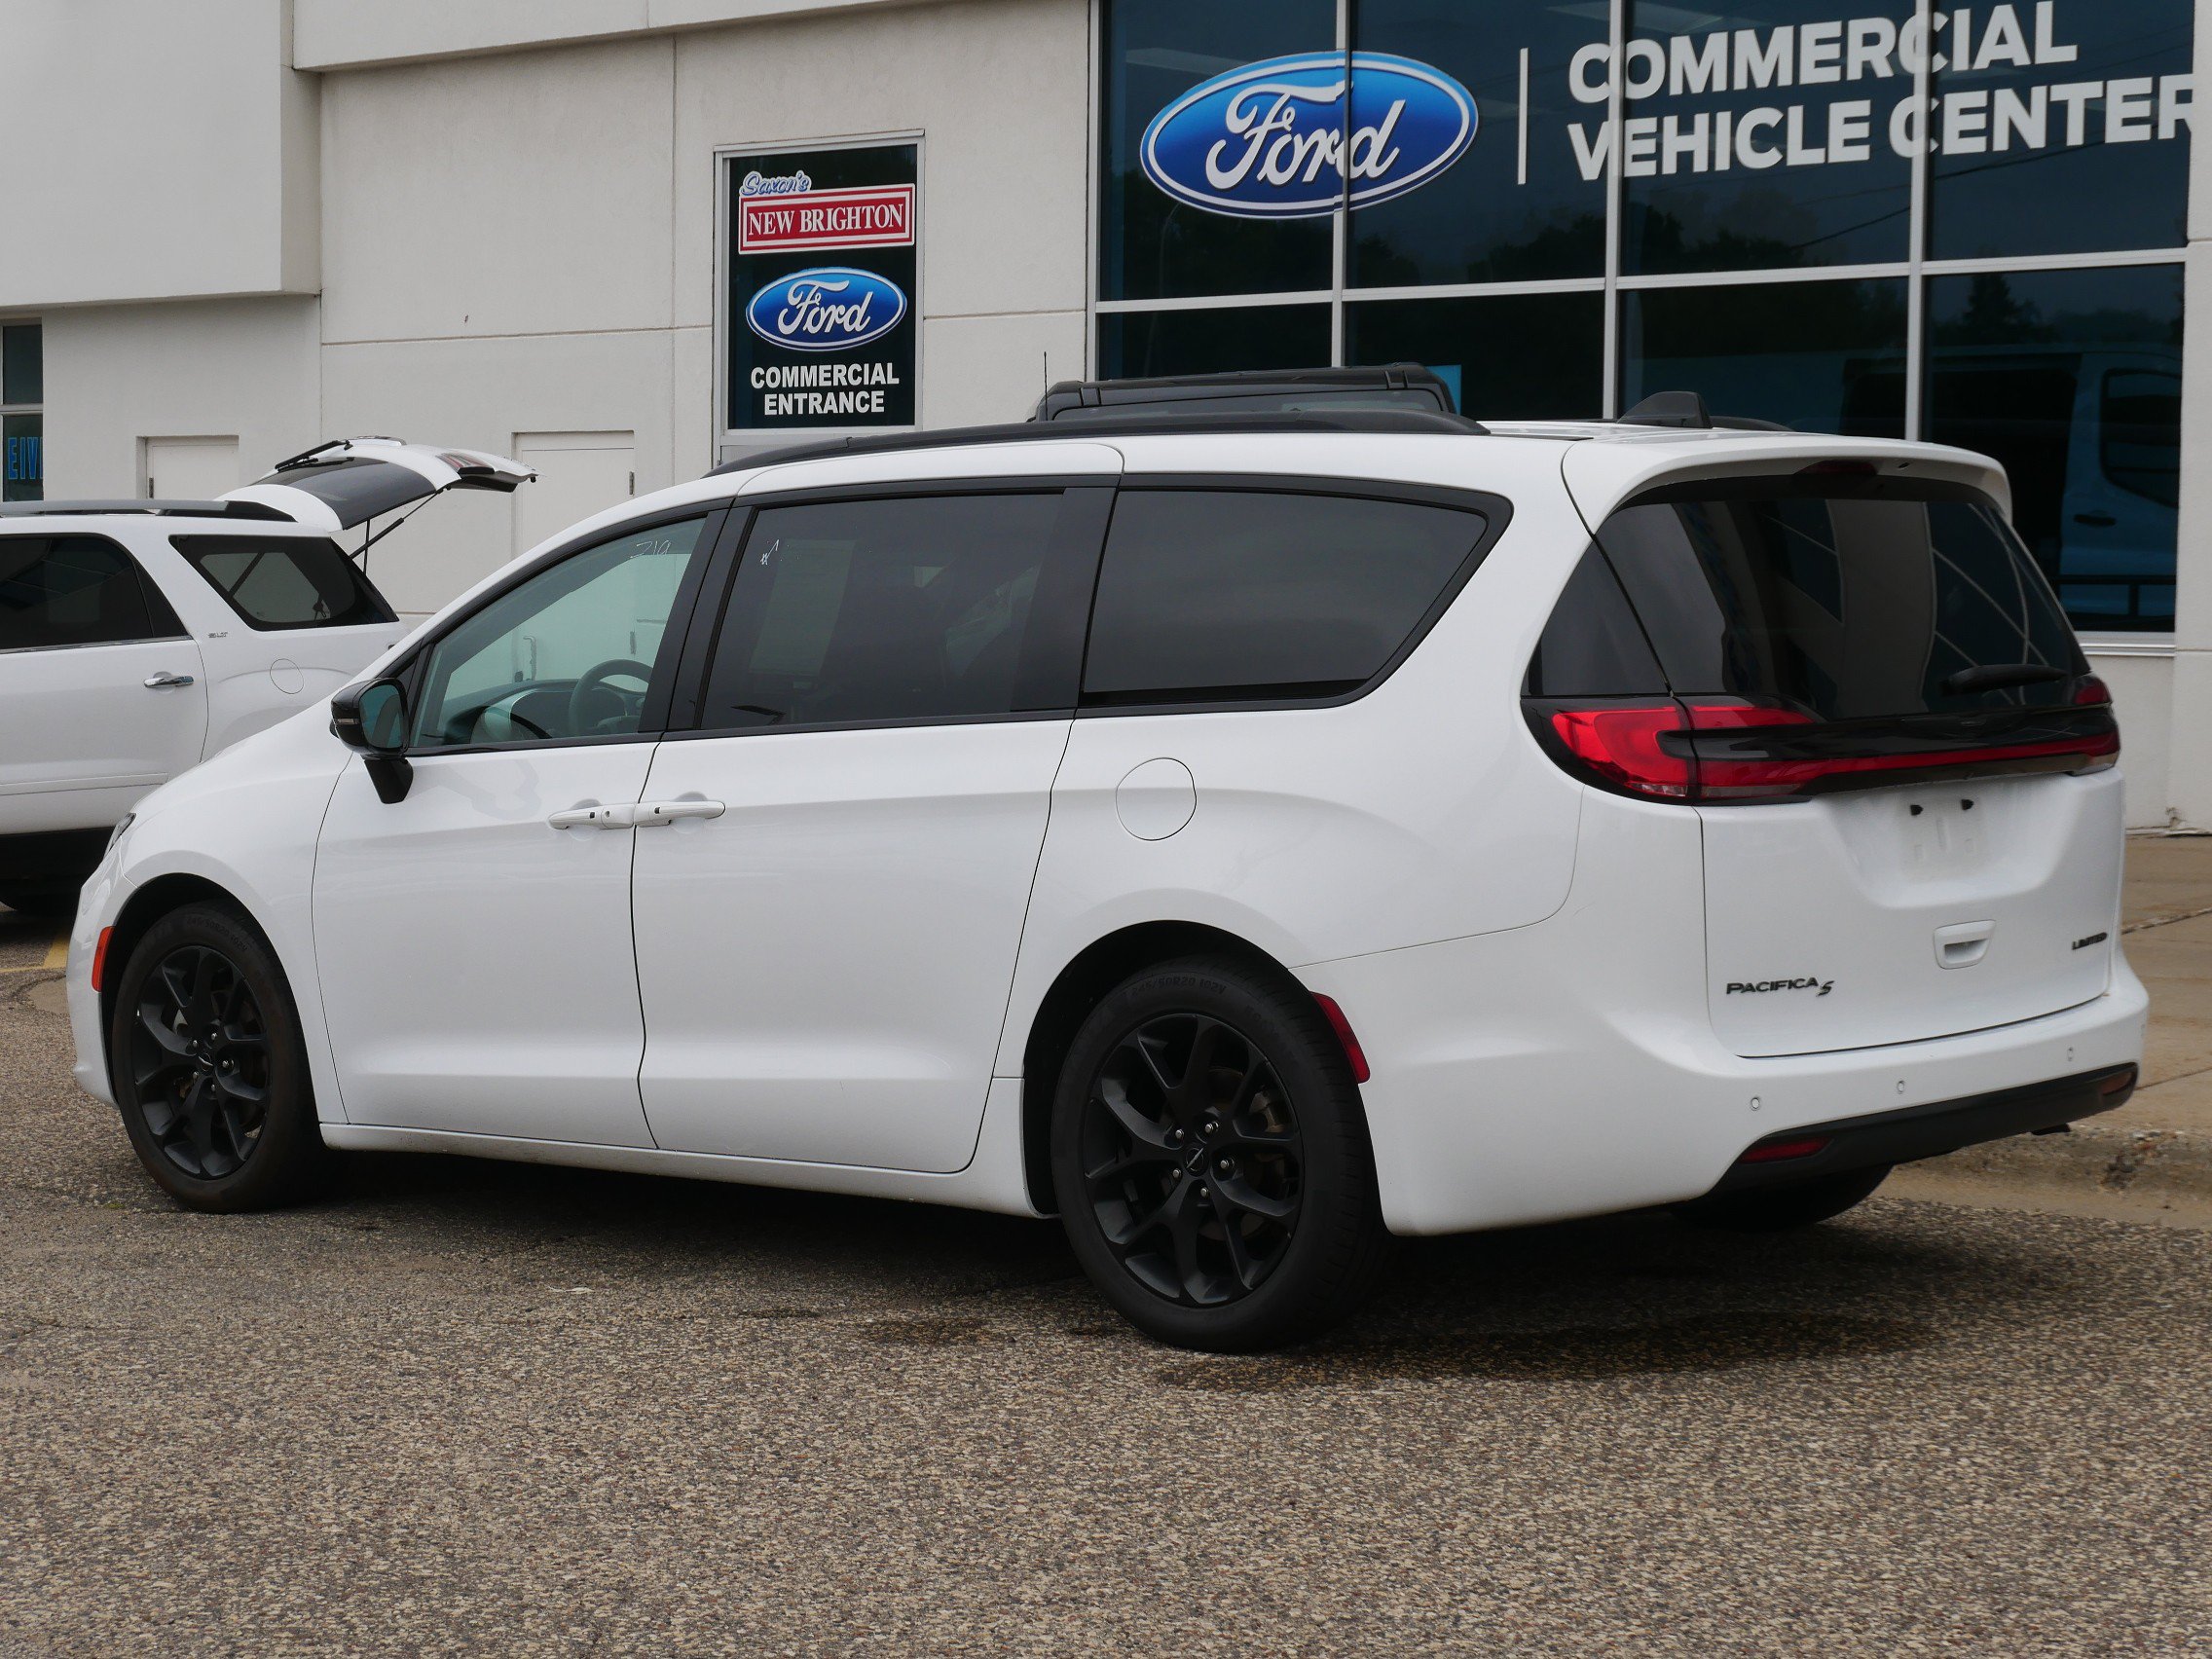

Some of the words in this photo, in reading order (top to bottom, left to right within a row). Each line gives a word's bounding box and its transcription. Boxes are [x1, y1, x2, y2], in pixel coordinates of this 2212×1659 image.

[1568, 1, 2078, 103] COMMERCIAL
[1205, 80, 1406, 190] Ford
[1567, 99, 1871, 181] VEHICLE
[1889, 73, 2196, 159] CENTER
[741, 170, 810, 197] Saxon's
[749, 210, 794, 236] NEW
[799, 203, 904, 233] BRIGHTON
[778, 279, 874, 335] Ford
[751, 362, 900, 389] COMMERCIAL
[764, 390, 885, 416] ENTRANCE
[1726, 977, 1819, 995] PACIFICA
[1815, 979, 1835, 998] S
